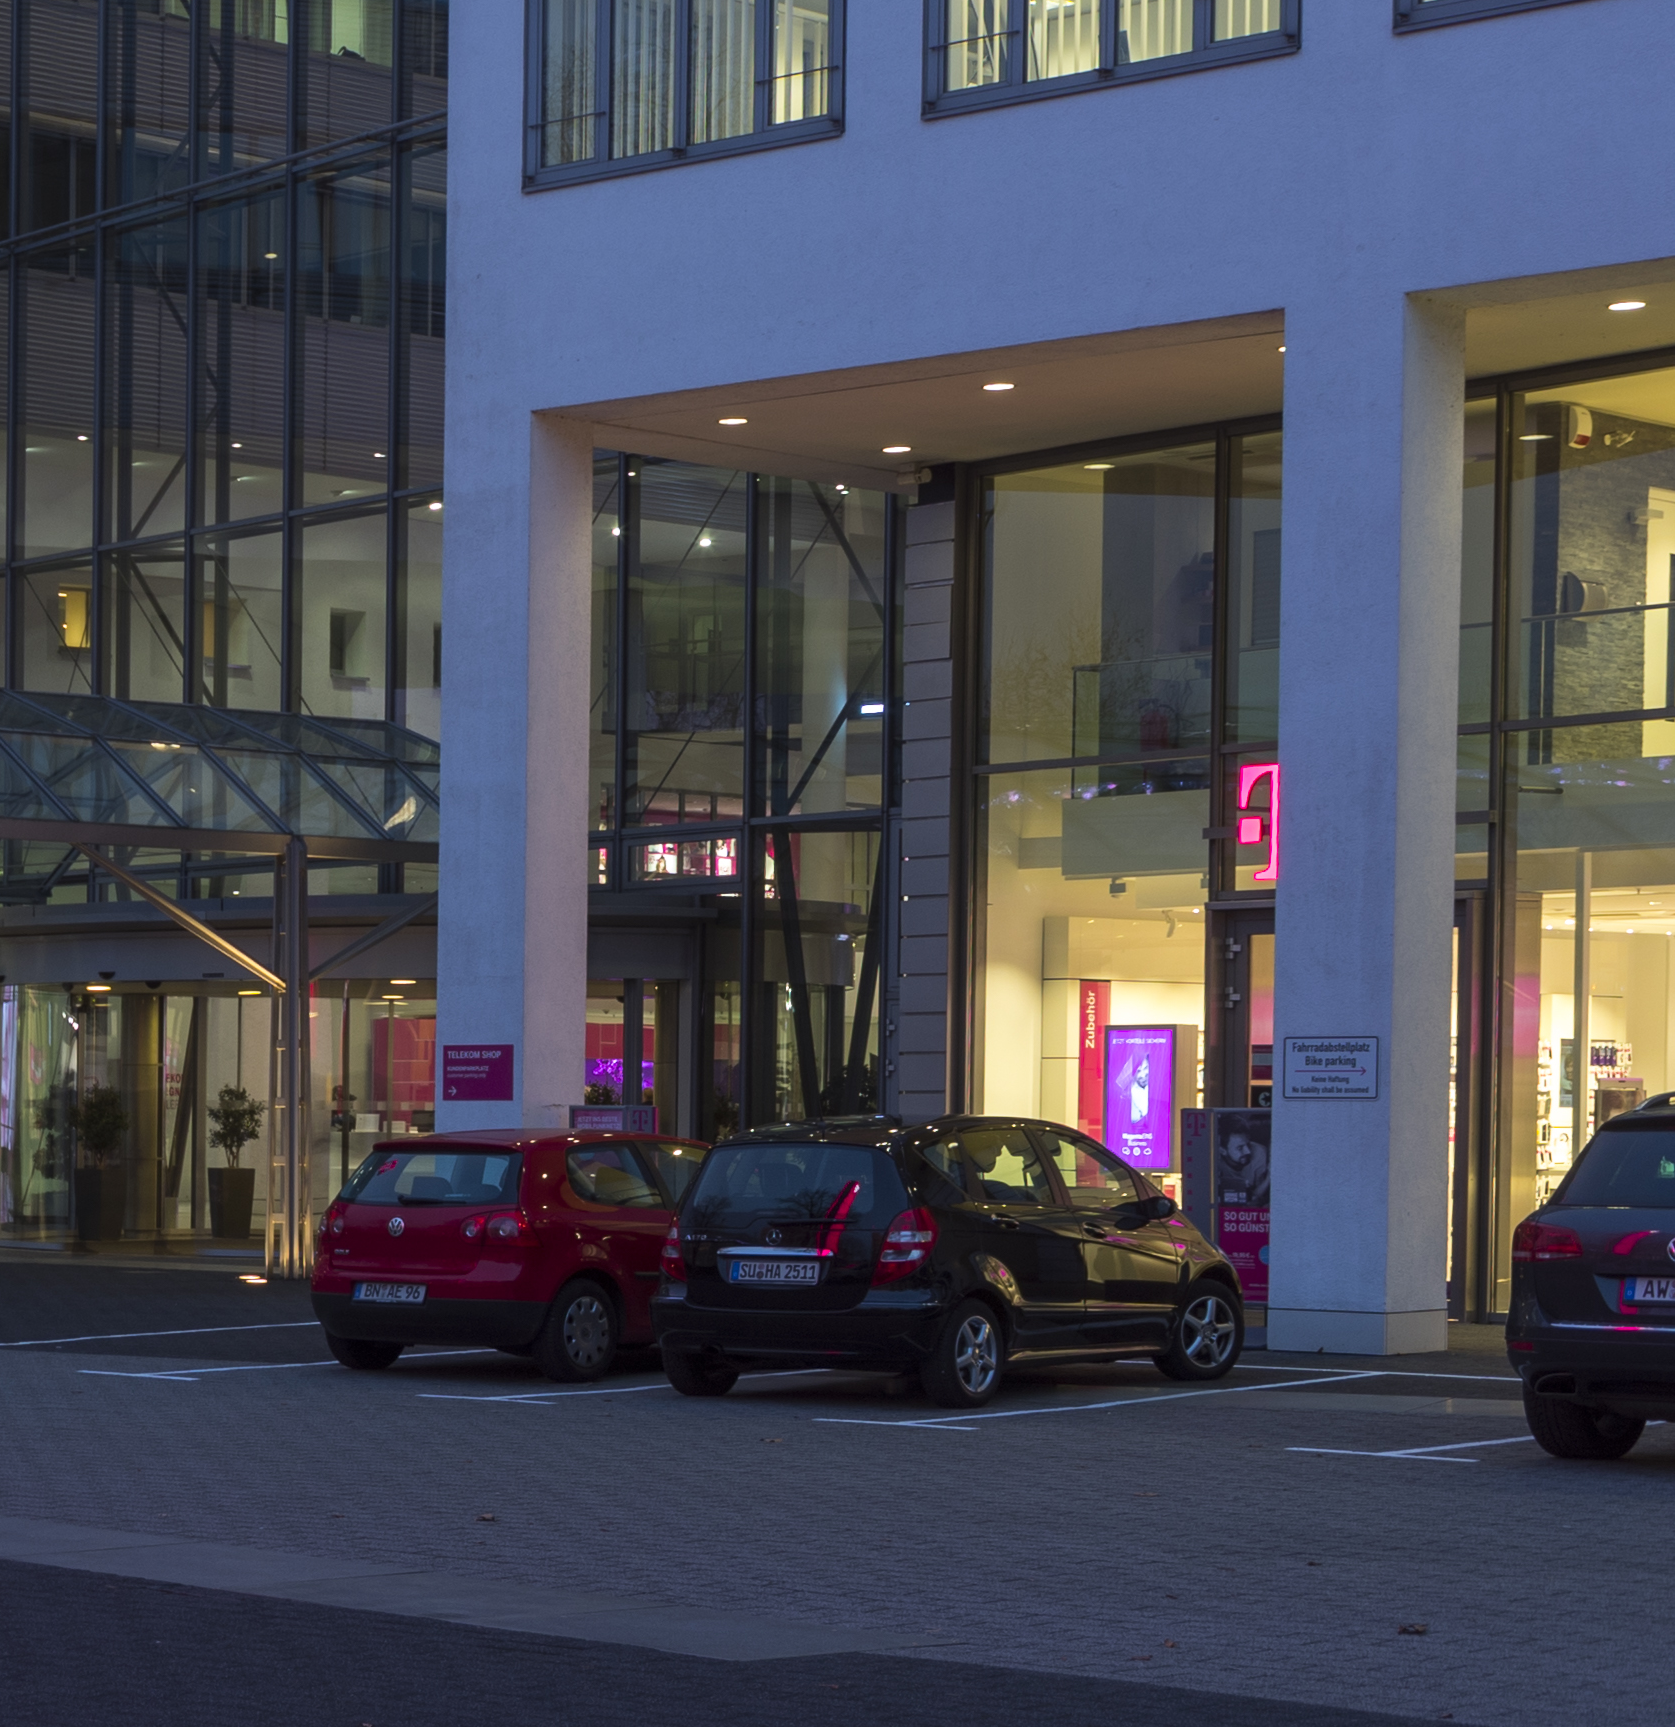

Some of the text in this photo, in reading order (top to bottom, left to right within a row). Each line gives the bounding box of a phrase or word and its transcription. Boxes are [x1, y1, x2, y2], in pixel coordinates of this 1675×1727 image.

[1085, 990, 1096, 1049] Zubehör
[447, 1050, 502, 1059] TELEKOM SHOP
[1292, 1042, 1370, 1054] Fahrradabstellplatz
[1305, 1055, 1357, 1068] Bike parking
[1328, 1076, 1350, 1084] Haftung
[1300, 1086, 1320, 1094] liability
[632, 1109, 648, 1132] T
[1186, 1112, 1206, 1137] T
[1223, 1211, 1237, 1221] SO
[1238, 1211, 1258, 1221] GUT
[1223, 1222, 1237, 1232] SO
[739, 1263, 816, 1280] SU HA 2511
[364, 1283, 421, 1300] BN AE 96
[1642, 1279, 1670, 1299] AW
